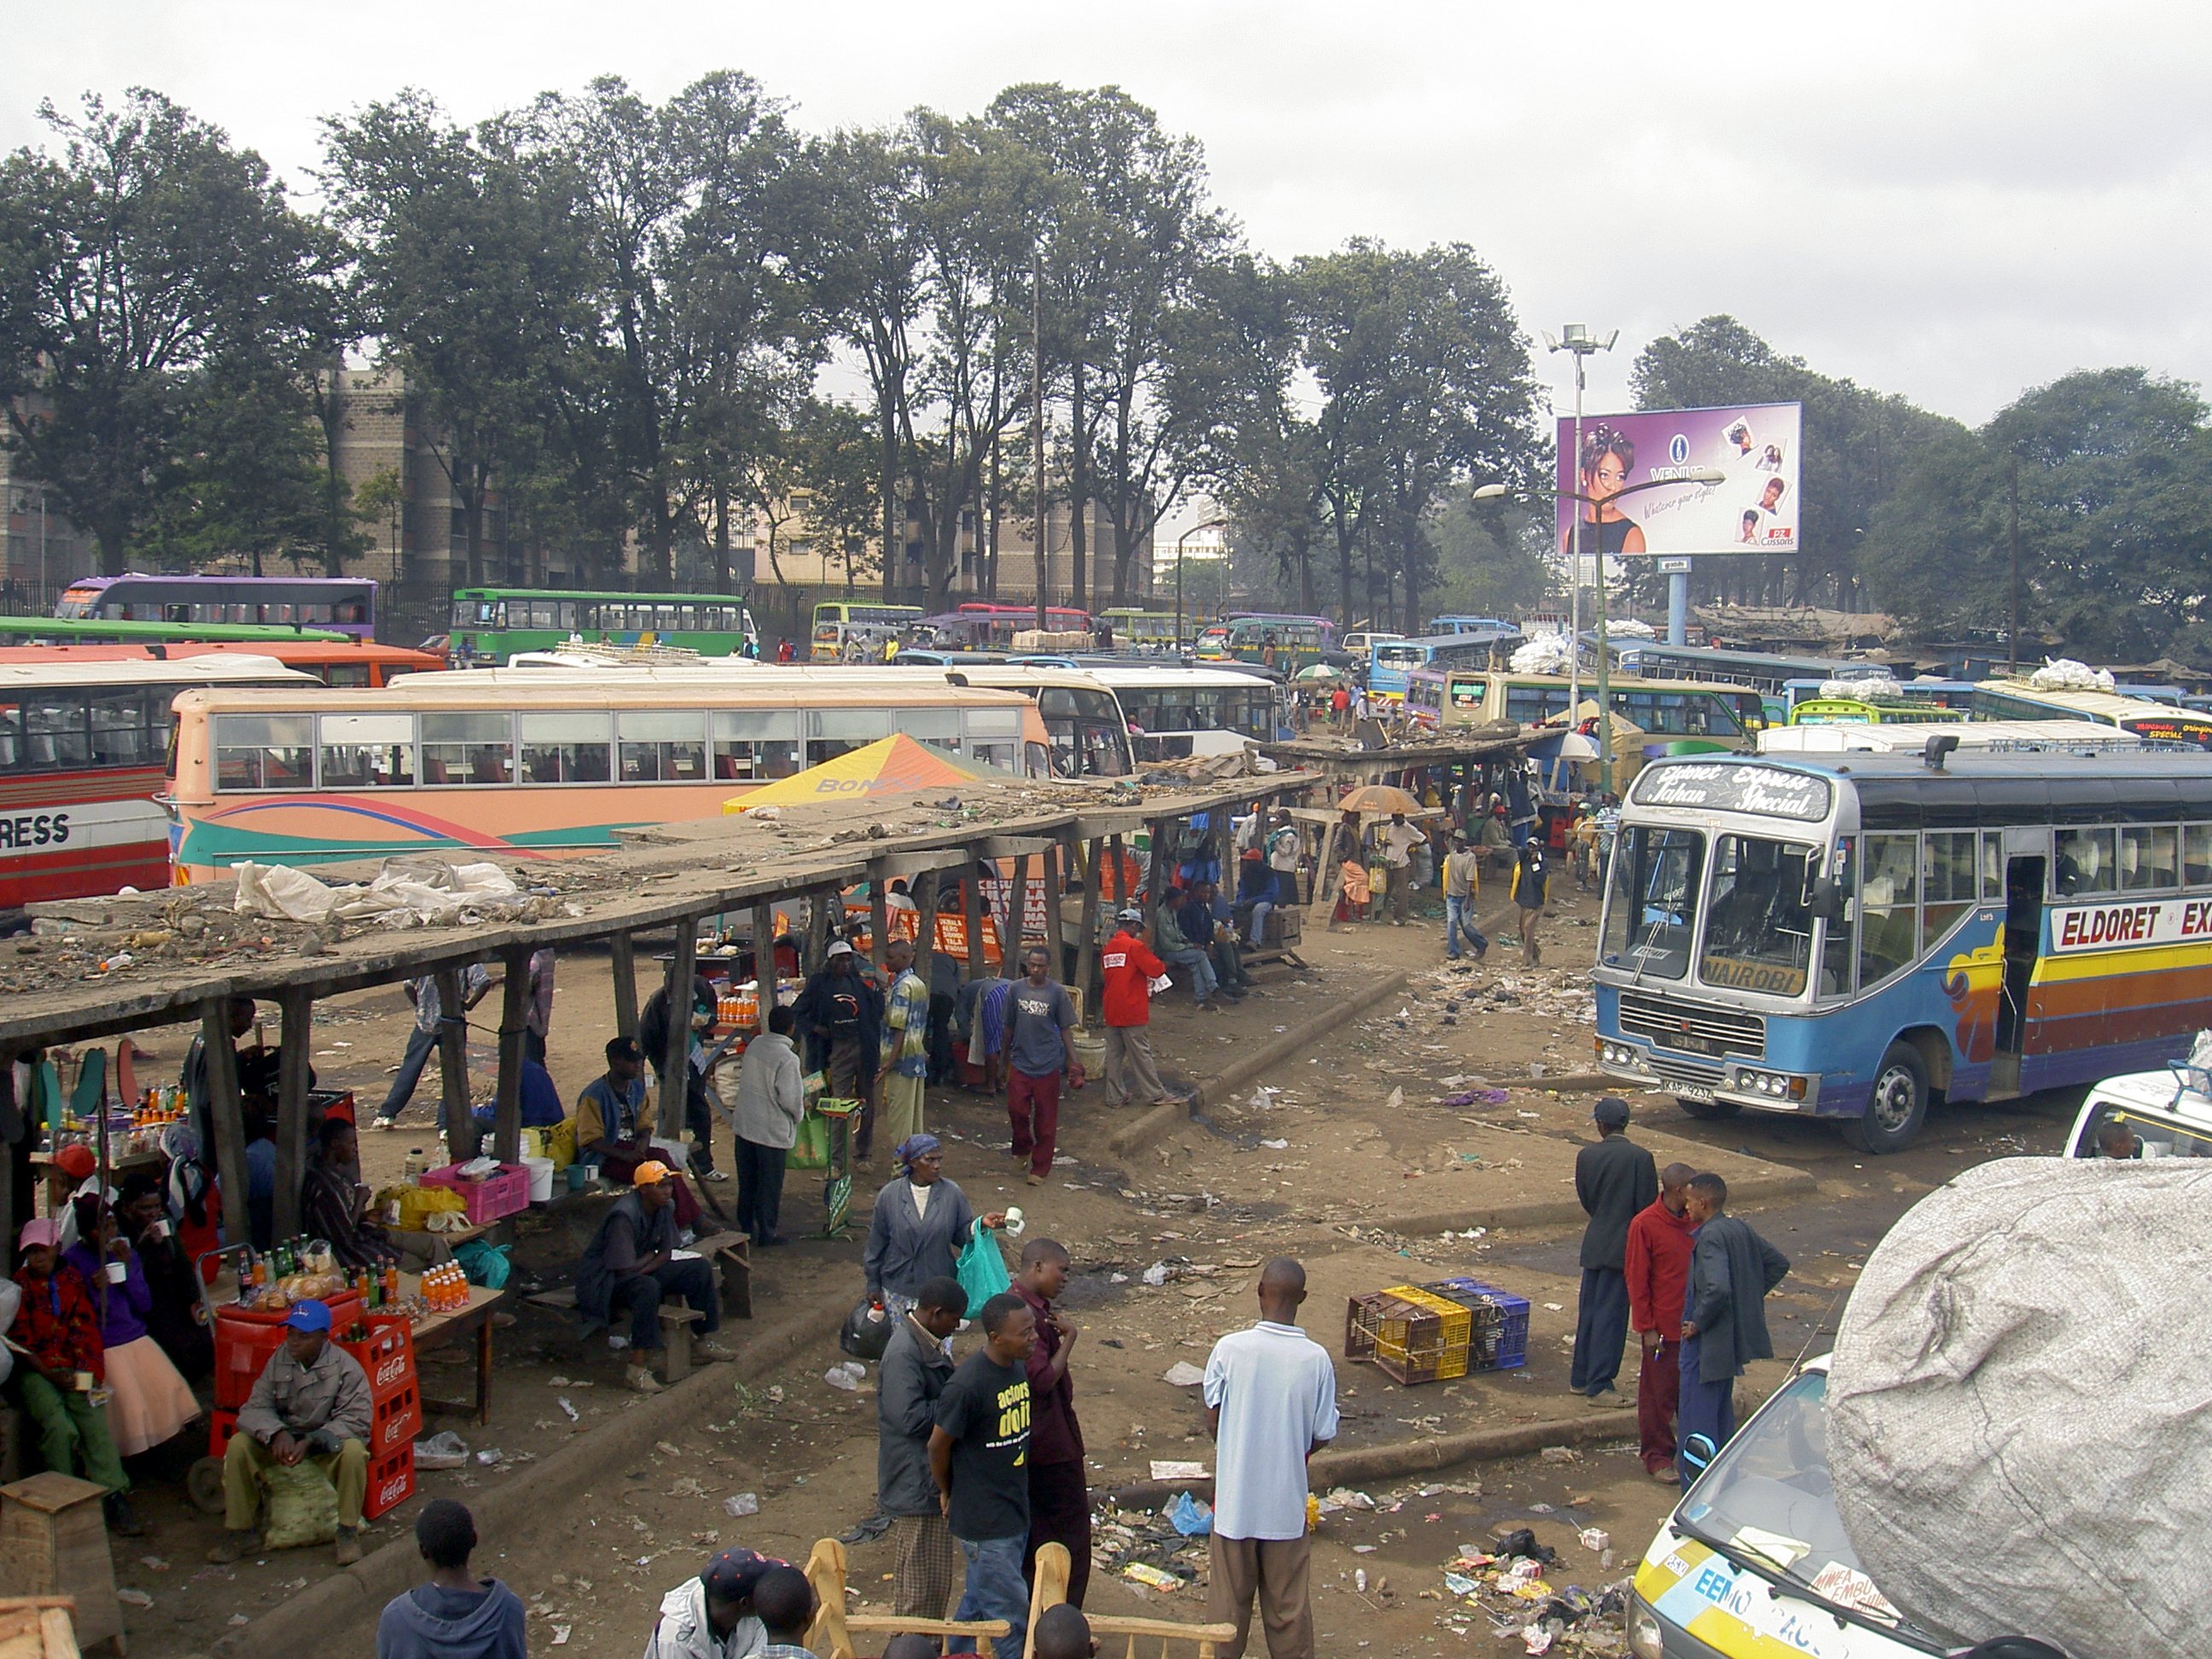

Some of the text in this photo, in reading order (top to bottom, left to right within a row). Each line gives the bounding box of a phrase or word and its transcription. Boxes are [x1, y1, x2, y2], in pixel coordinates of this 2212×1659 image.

[1644, 486, 1717, 520] Whatever your style!
[1761, 537, 1794, 546] Cussons
[1657, 765, 1811, 791] Eldoret Express
[1735, 785, 1812, 815] Special
[2061, 901, 2212, 946] ELDORET EX
[1703, 960, 1796, 992] NAIROBI
[1029, 998, 1050, 1008] PENN
[1665, 1080, 1683, 1092] KAP
[998, 1381, 1030, 1410] actors
[1812, 1569, 1853, 1591] MWEA
[1831, 1578, 1873, 1604] EMBU
